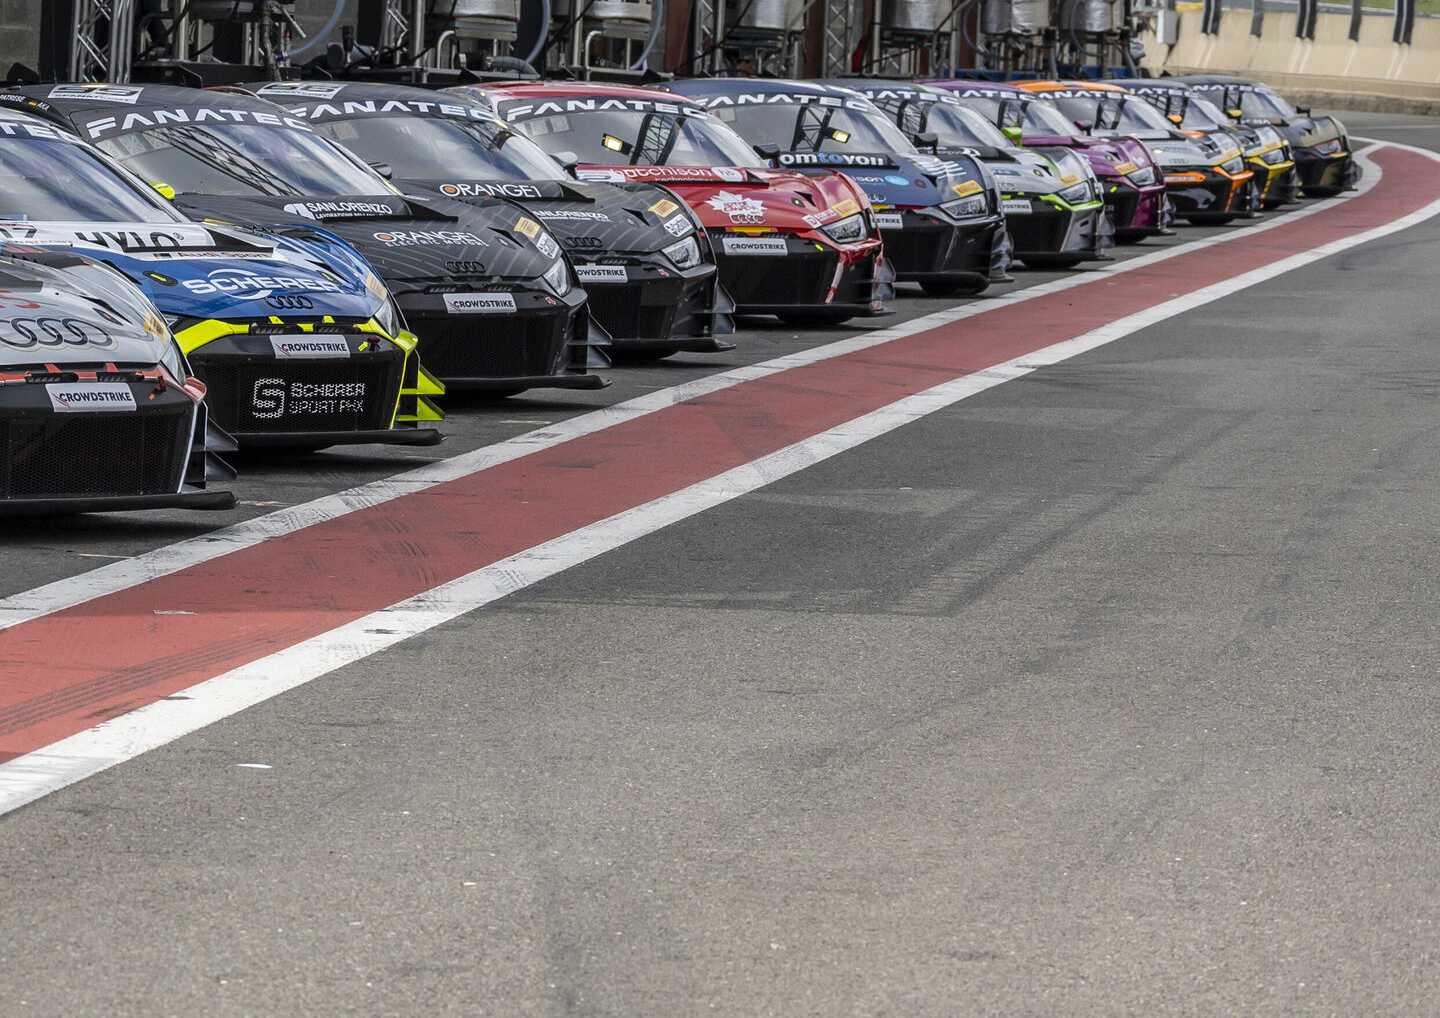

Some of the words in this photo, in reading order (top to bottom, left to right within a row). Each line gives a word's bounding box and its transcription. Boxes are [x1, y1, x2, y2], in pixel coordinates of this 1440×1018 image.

[1192, 84, 1268, 94] NATEC
[862, 90, 960, 105] NATEC
[1039, 90, 1143, 103] ANATEC
[36, 101, 50, 111] AKA
[289, 100, 494, 123] FANATEC
[507, 99, 708, 121] FANATEC
[86, 109, 312, 139] FANATEC
[780, 152, 883, 166] omtoyou
[439, 184, 542, 198] ORANGE1
[306, 202, 392, 215] SANLORENZO
[532, 210, 608, 219] ANLORENZO
[373, 230, 482, 244] ORANGE1
[443, 238, 489, 248] MOTORS
[577, 269, 625, 277] OWDSTRIKE
[182, 275, 343, 296] SCHERER
[453, 299, 514, 309] CROWDSTRIKE
[281, 342, 348, 352] CROWDSTRIKE
[291, 383, 365, 397] SCHERER
[59, 391, 132, 403] CROWDSTRIKE
[289, 400, 337, 413] SPORT
